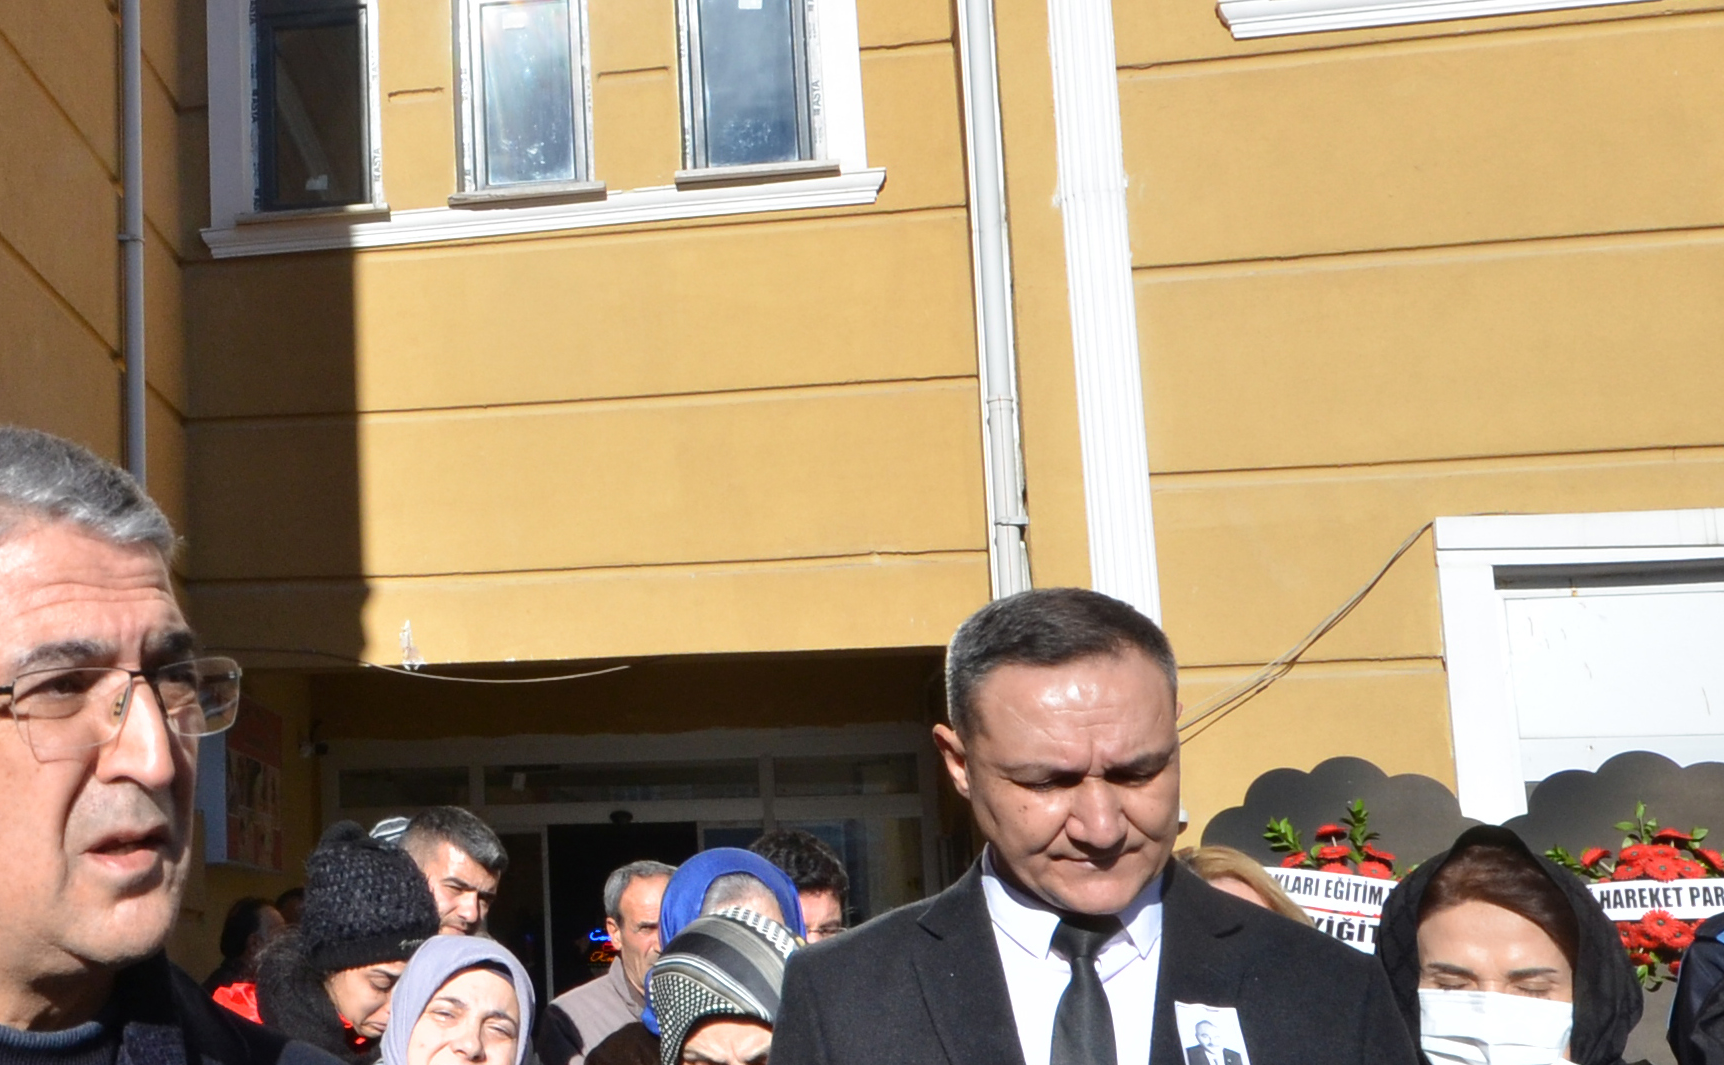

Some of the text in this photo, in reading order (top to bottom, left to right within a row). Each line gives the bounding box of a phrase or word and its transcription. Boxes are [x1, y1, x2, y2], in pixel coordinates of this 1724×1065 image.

[1325, 876, 1384, 906] EĞİTİM
[1600, 886, 1724, 909] HAREKET PAR
